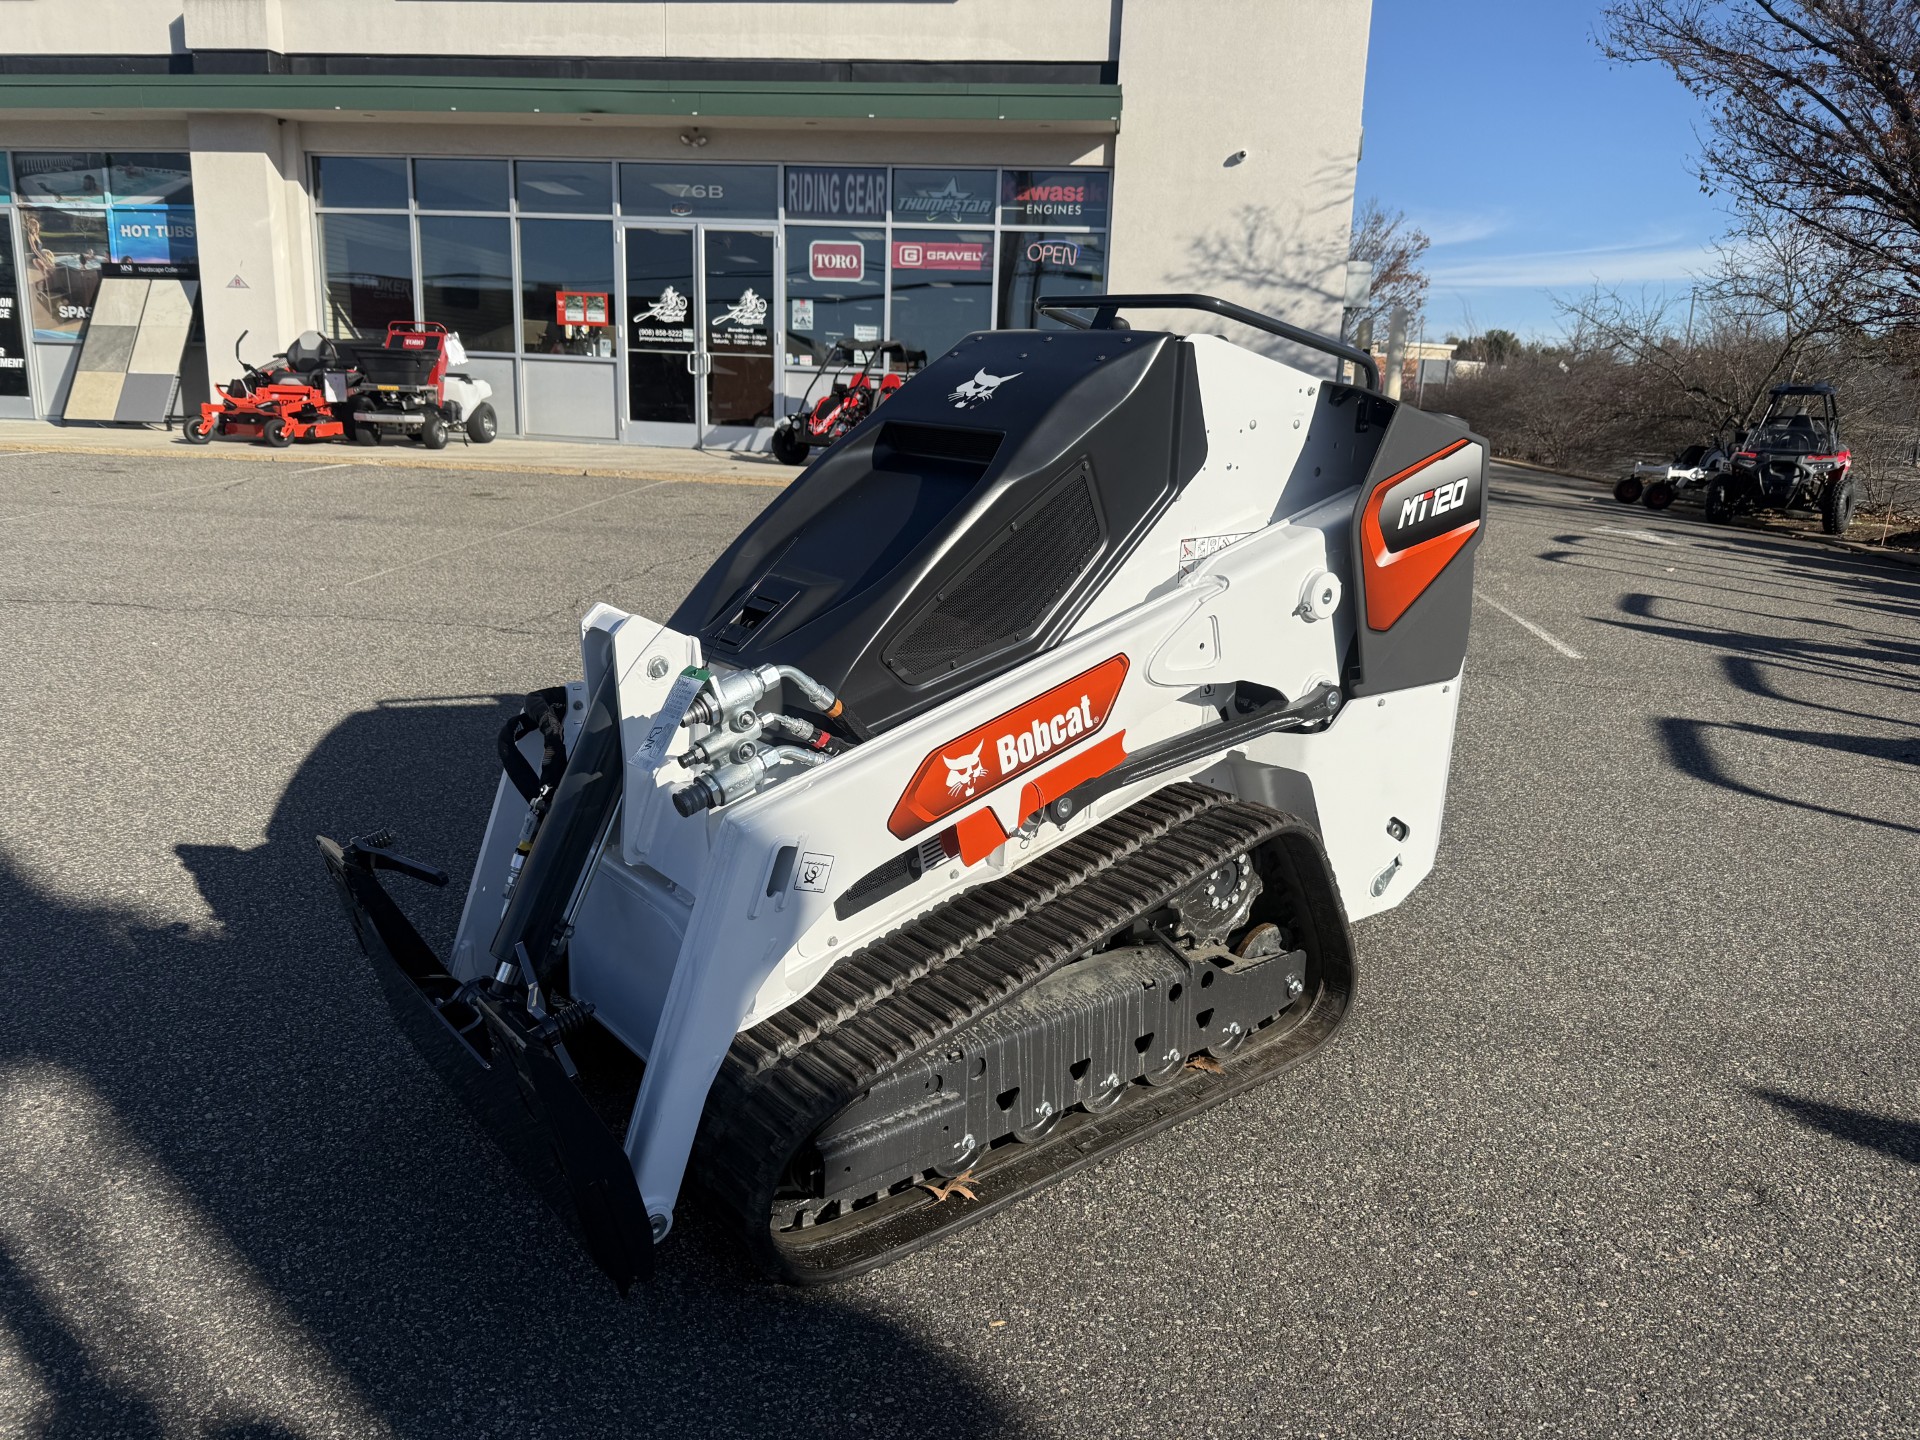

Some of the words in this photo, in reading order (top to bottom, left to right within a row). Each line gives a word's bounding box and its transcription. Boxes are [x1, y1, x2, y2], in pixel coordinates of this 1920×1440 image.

[677, 184, 724, 199] 76B
[788, 173, 840, 213] RIDING
[845, 174, 885, 214] GEAR
[1026, 204, 1082, 215] ENGINES
[121, 225, 151, 238] HOT
[155, 225, 194, 238] TUBS
[814, 254, 858, 269] TORO
[926, 251, 988, 261] GRAVELY
[1027, 243, 1078, 266] OPEN
[1397, 477, 1469, 530] MT120
[996, 694, 1094, 775] Bobcat
